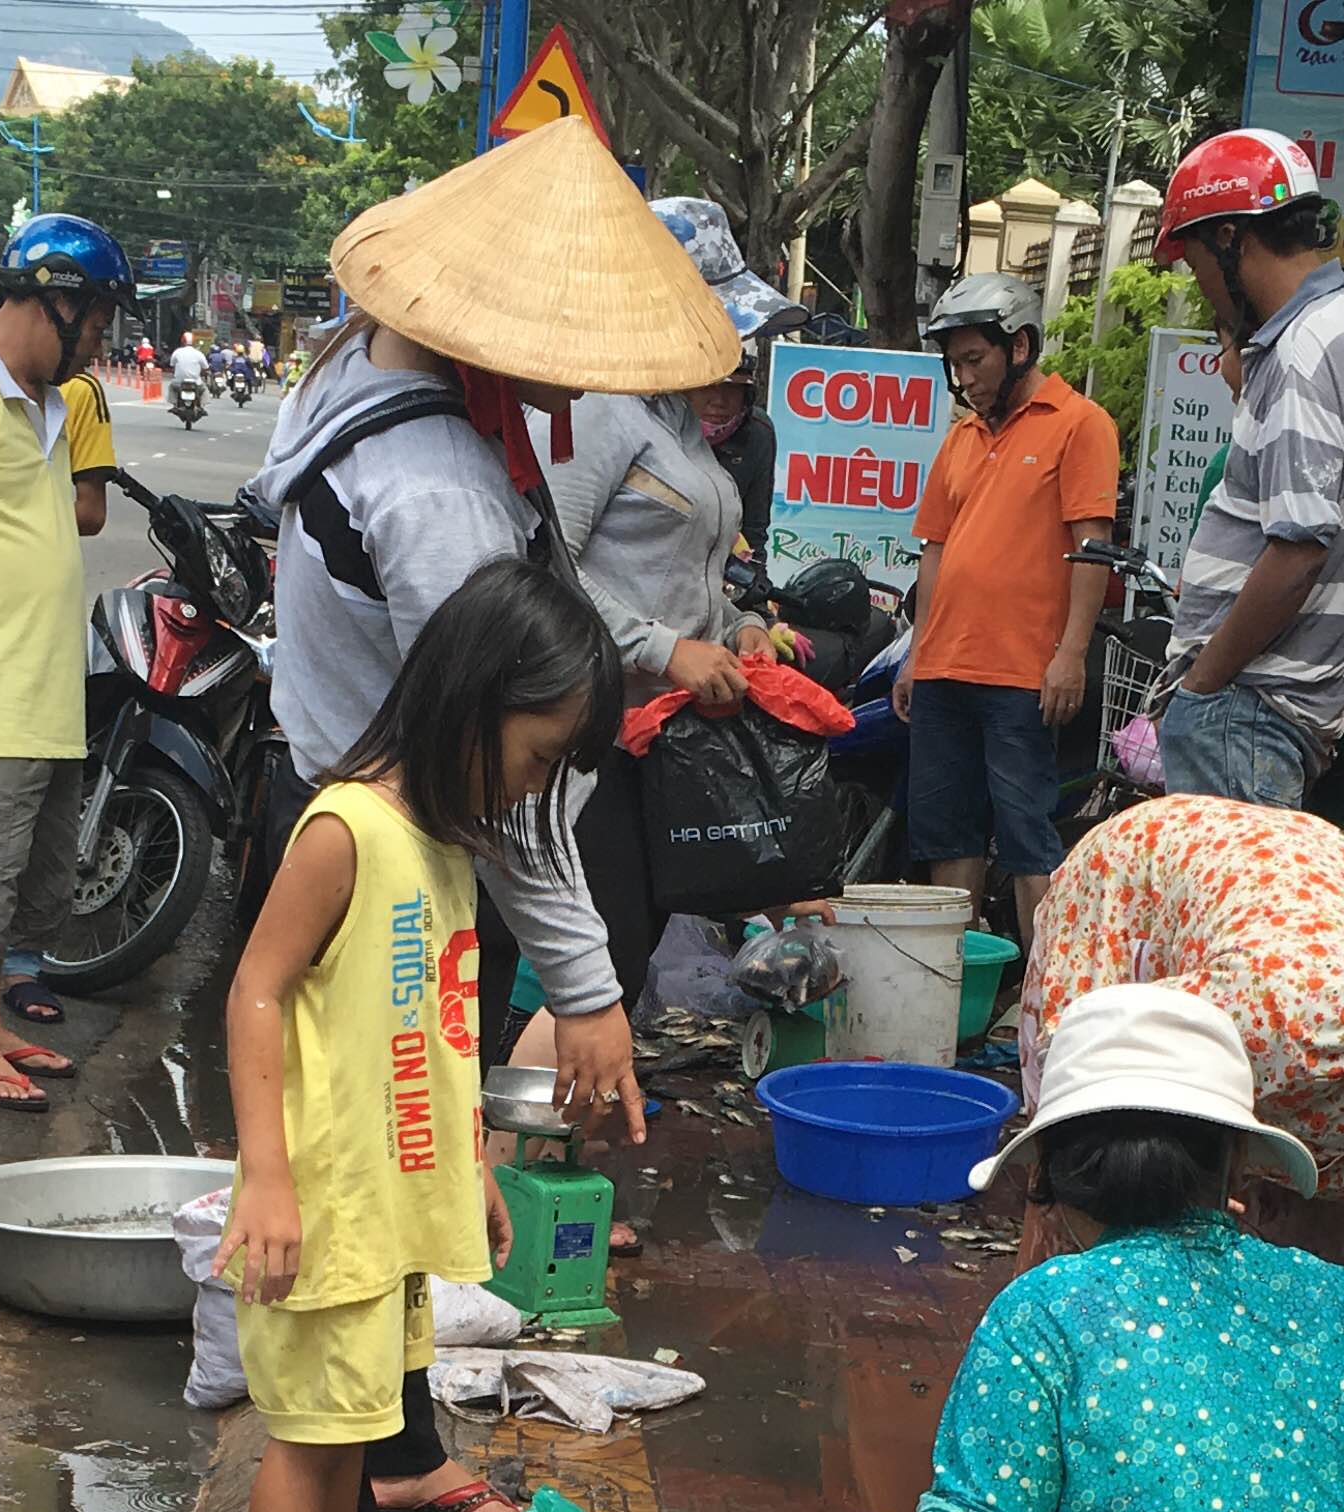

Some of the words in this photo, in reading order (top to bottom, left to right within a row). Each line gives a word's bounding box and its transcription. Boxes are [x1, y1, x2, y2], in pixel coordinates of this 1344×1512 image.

[1296, 47, 1337, 66] rau
[1296, 130, 1337, 178] ẢI
[1183, 176, 1249, 200] mobifone
[787, 369, 933, 427] CƠM
[1172, 397, 1209, 421] Súp
[1170, 424, 1208, 443] Rau
[1215, 427, 1233, 444] lu
[1167, 449, 1208, 469] Kho
[786, 446, 920, 511] NIÊU
[1161, 500, 1197, 523] Ngh
[771, 528, 827, 562] Rau
[1158, 526, 1182, 544] Sò
[670, 828, 701, 842] HA
[392, 889, 425, 1007] SQUAL
[402, 1008, 419, 1028] &
[391, 1031, 428, 1082] NO
[394, 1089, 436, 1173] ROWI
